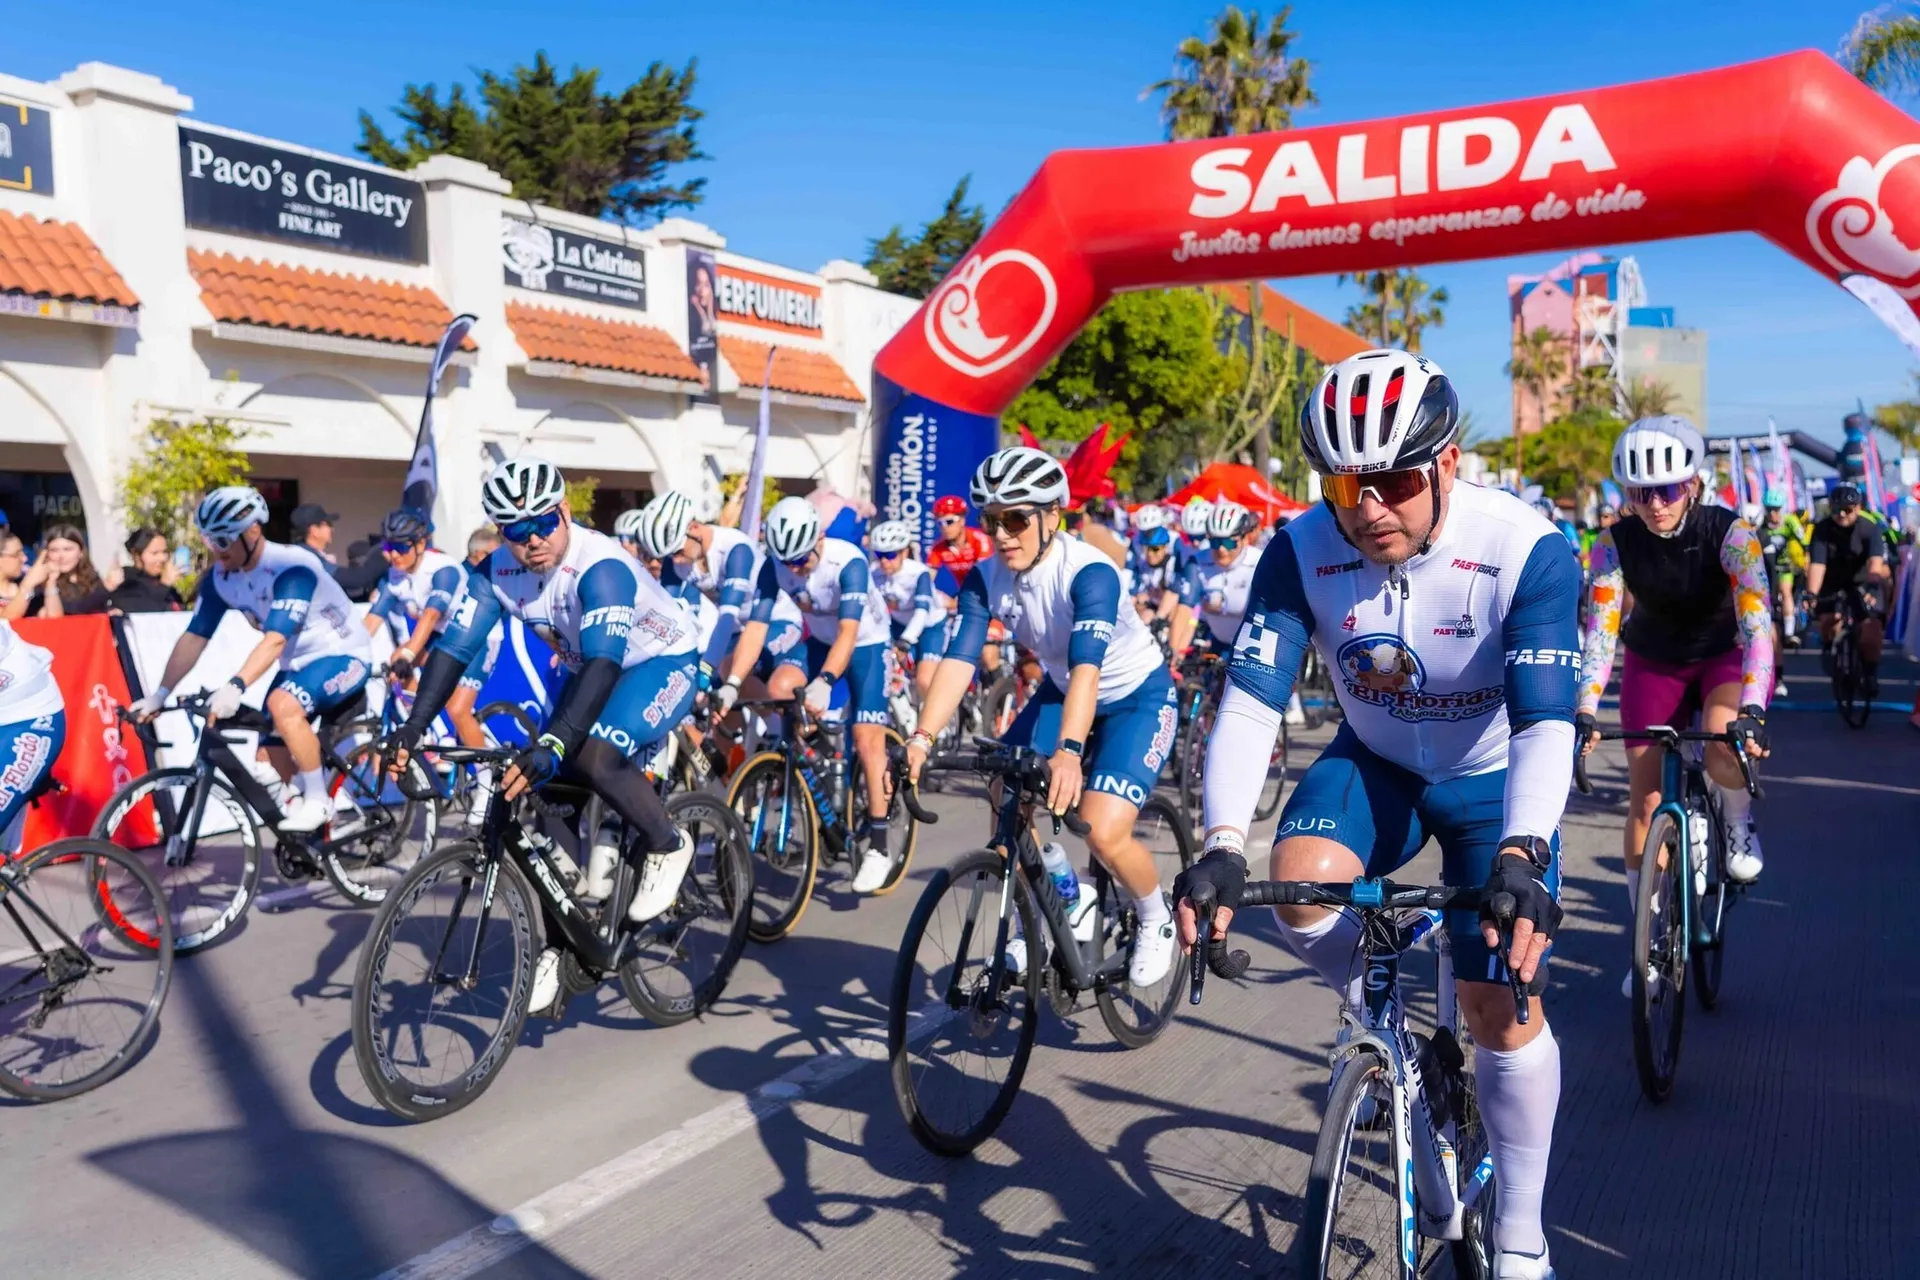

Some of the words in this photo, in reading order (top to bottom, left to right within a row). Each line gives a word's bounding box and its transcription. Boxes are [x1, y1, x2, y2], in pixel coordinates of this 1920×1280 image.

[187, 141, 298, 197] Paco's
[305, 168, 412, 228] Gallery
[1187, 103, 1618, 218] SALIDA
[279, 212, 313, 234] FINE
[313, 220, 343, 239] ART
[556, 236, 581, 267] La
[582, 243, 643, 280] Catrina
[1172, 228, 1261, 263] Juntos
[1269, 221, 1361, 250] damos
[1369, 202, 1523, 246] esperanza
[1531, 190, 1571, 222] de
[1575, 183, 1647, 214] vida
[884, 452, 902, 521] dación
[898, 413, 924, 561] TRO-LIMÓN
[1351, 684, 1382, 702] El
